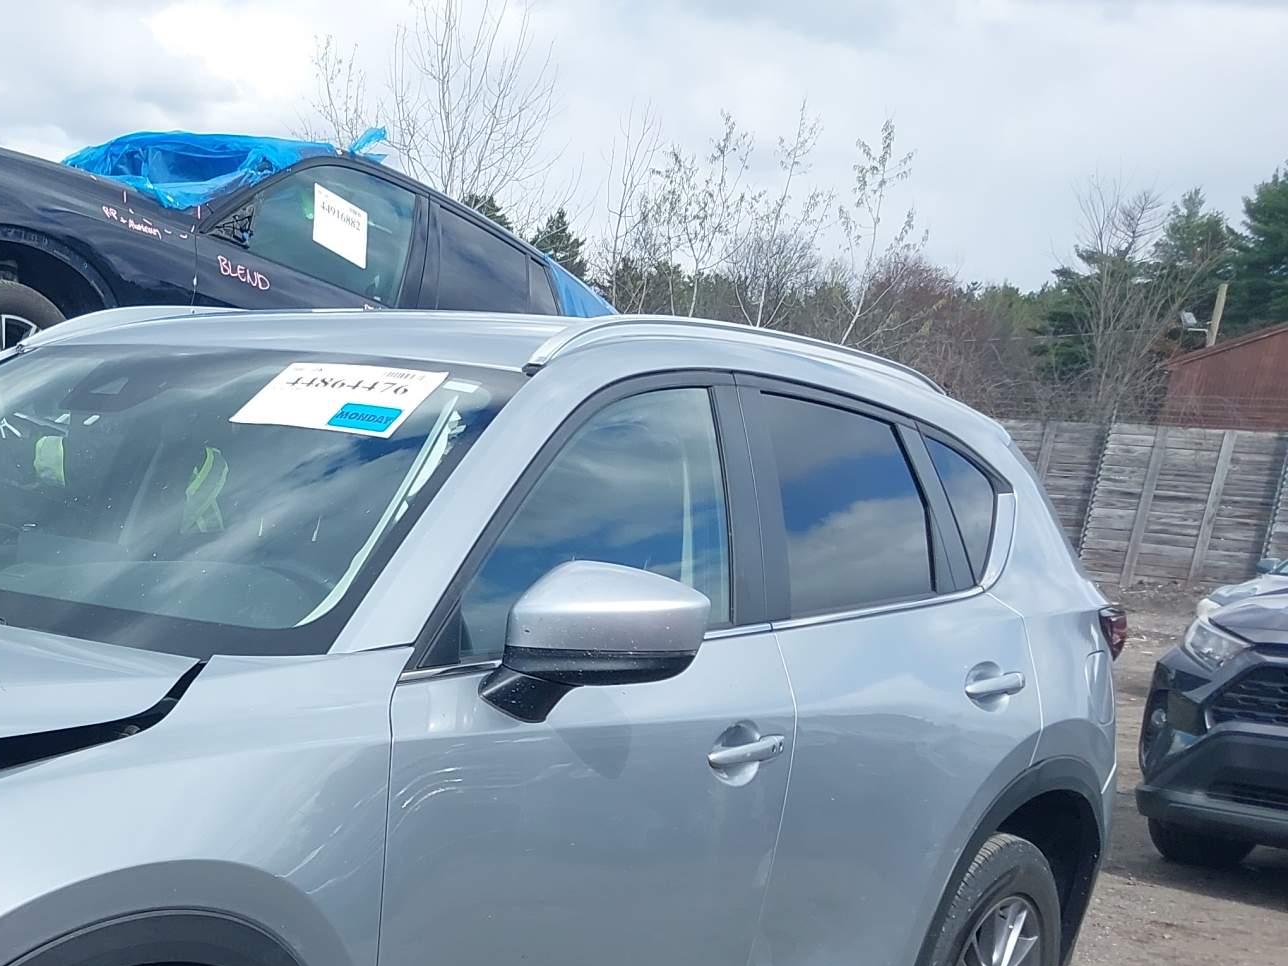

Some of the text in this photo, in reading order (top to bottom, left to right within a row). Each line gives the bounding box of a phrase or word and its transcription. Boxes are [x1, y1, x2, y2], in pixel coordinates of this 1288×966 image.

[217, 255, 270, 290] BLEND
[286, 375, 409, 396] 44864476
[336, 409, 393, 425] MONDAY
